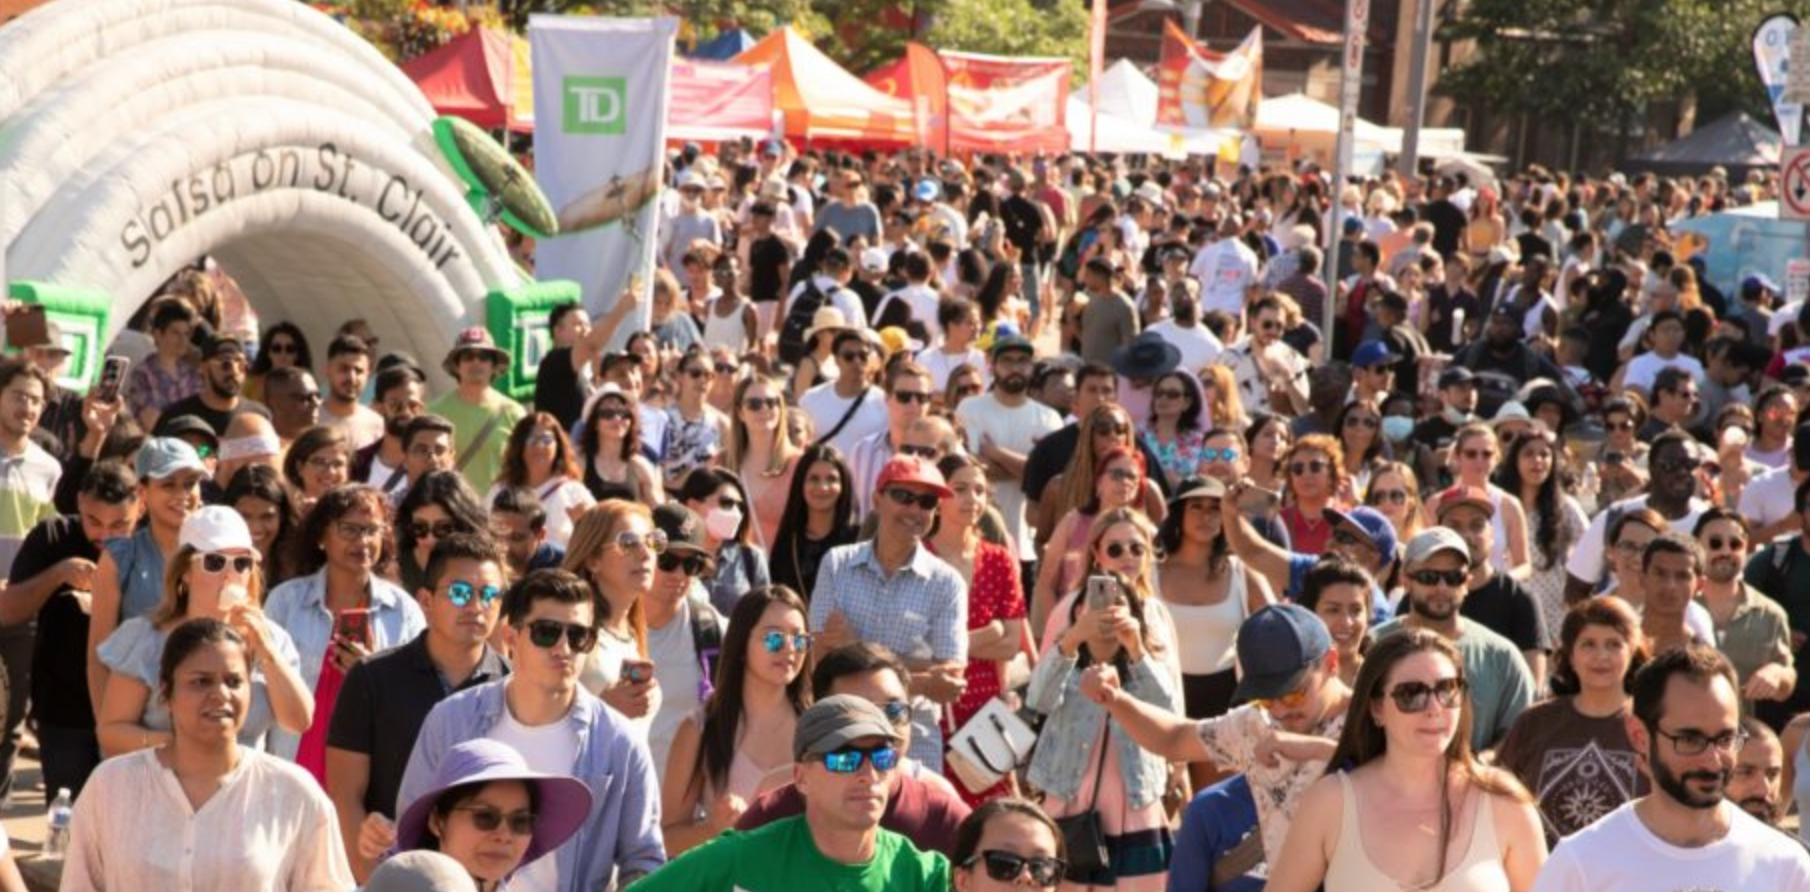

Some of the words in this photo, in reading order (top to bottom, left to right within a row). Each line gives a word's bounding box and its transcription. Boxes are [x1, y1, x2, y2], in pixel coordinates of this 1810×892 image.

[568, 86, 621, 123] TD
[120, 164, 235, 269] Salsa
[252, 149, 299, 189] on
[314, 142, 357, 202] St.
[377, 174, 460, 269] Clair
